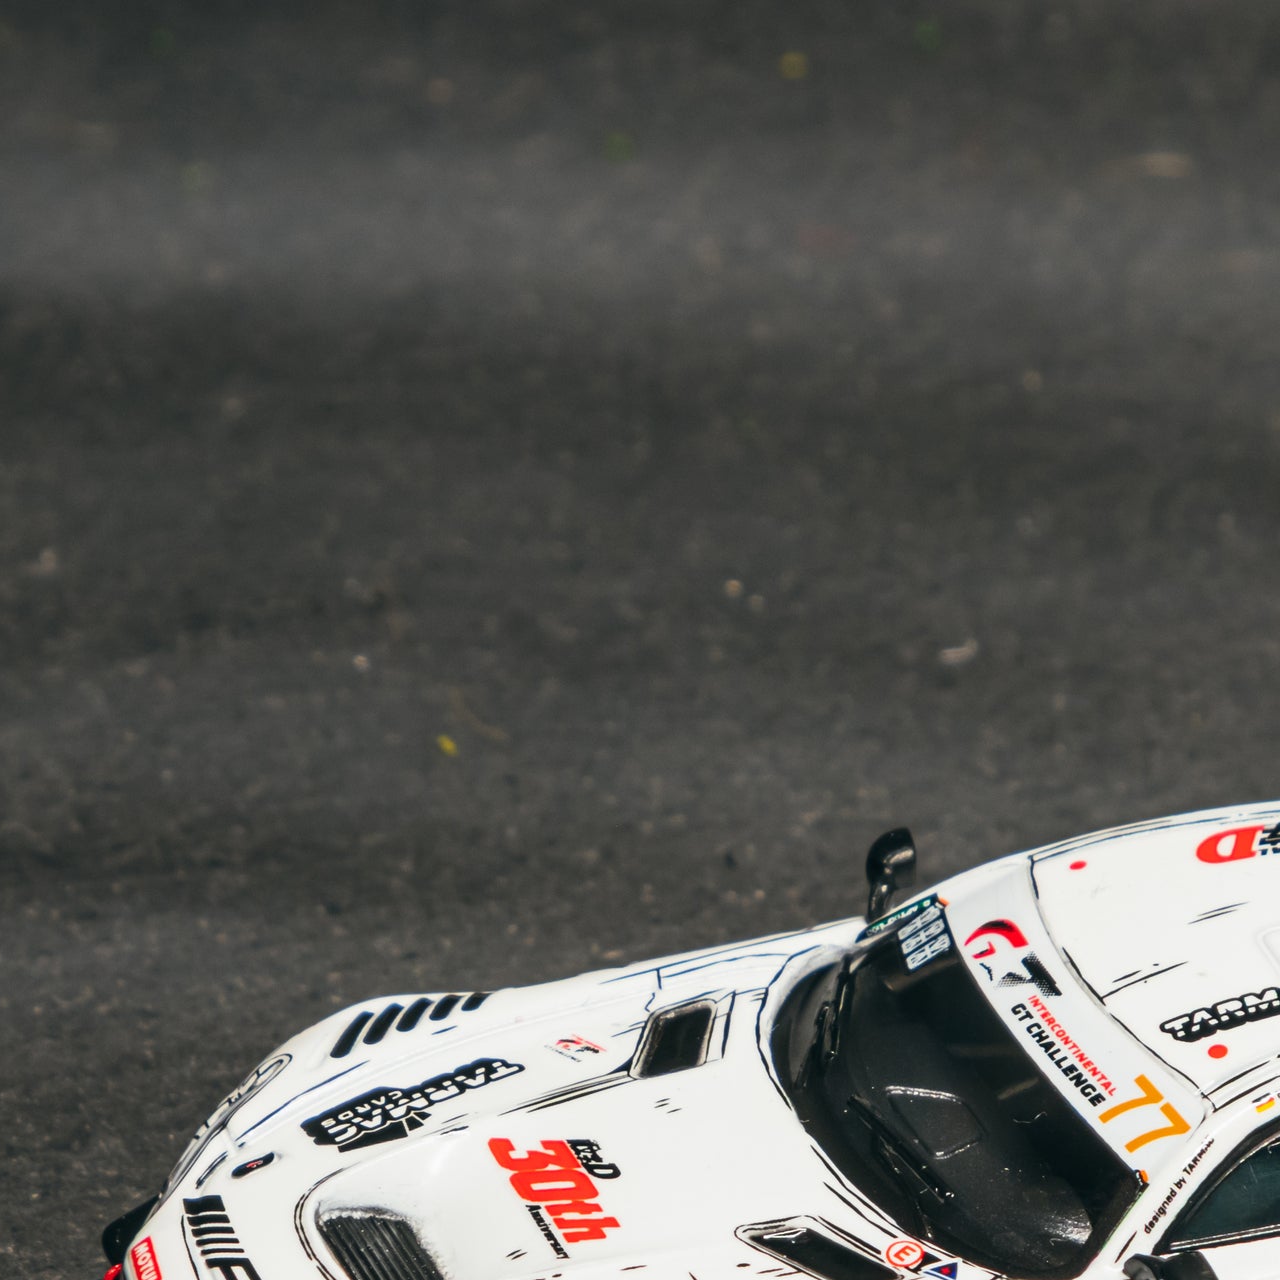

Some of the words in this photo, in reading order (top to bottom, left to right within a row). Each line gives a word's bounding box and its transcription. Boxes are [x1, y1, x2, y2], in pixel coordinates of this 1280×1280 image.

[1010, 1003, 1035, 1022] GT
[1026, 1022, 1107, 1107] CHALLENGE
[1028, 995, 1118, 1097] INTERCONTINENTAL
[321, 1090, 404, 1128] CARDS
[327, 1061, 520, 1143] TARMAC
[1098, 1074, 1192, 1154] 77
[488, 1137, 621, 1244] 30th
[525, 1204, 570, 1260] Anniversary
